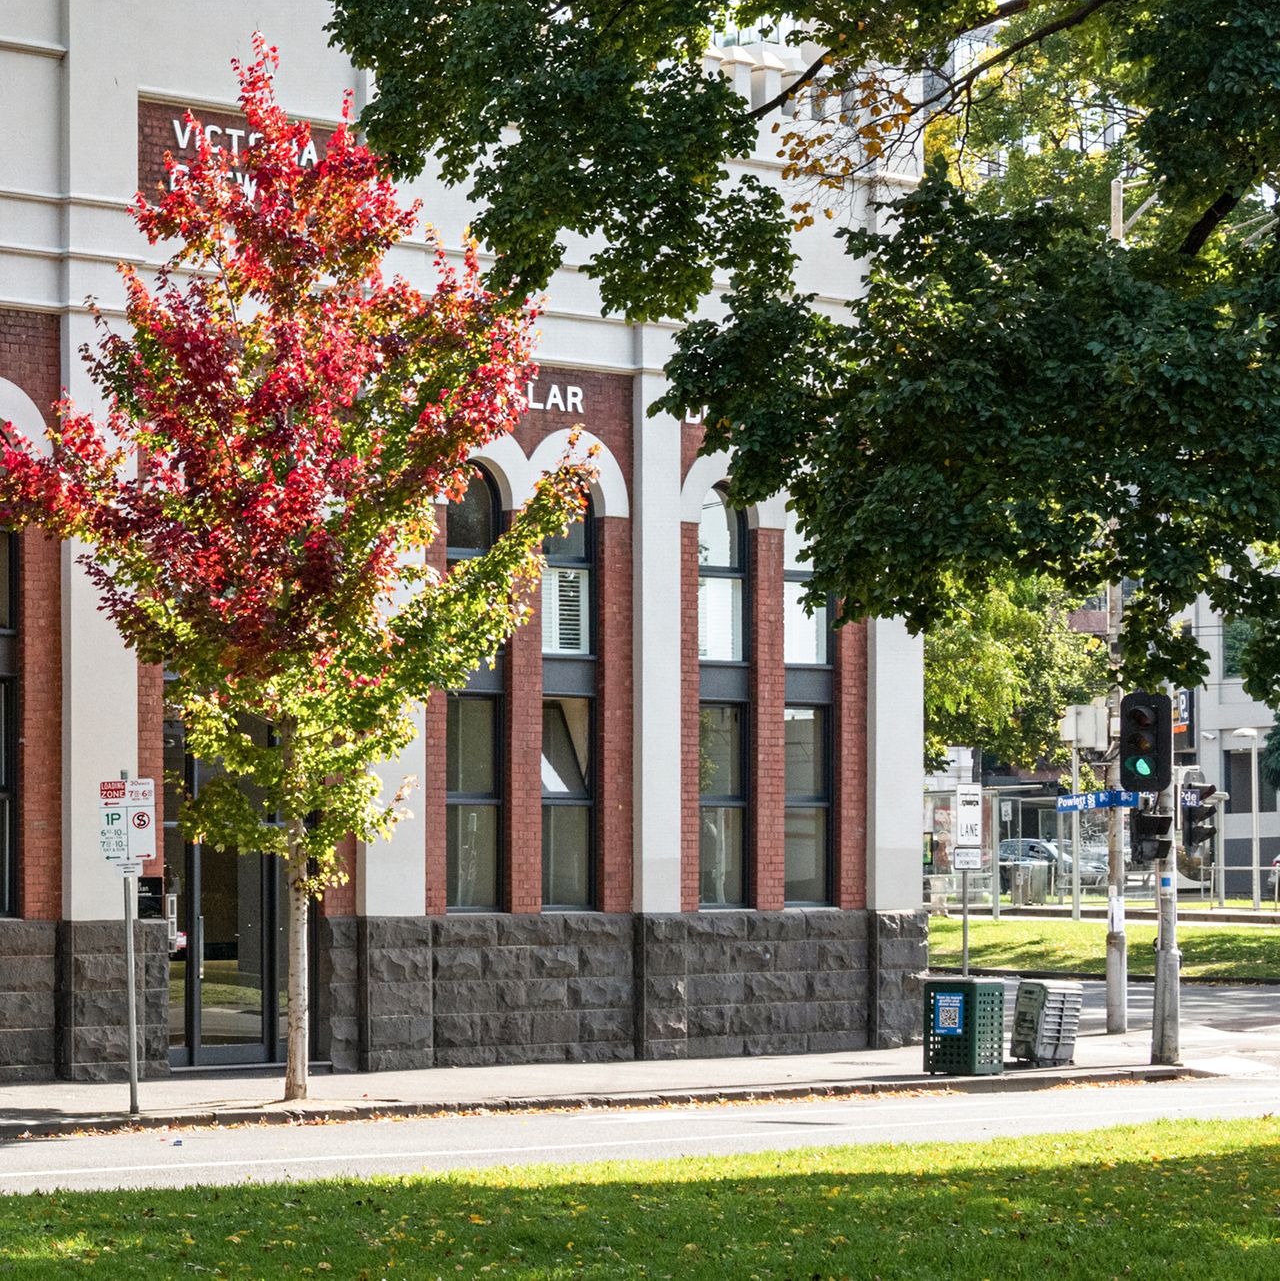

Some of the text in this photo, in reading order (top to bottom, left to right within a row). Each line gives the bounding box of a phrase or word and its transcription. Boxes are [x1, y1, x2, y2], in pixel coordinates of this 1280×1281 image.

[173, 120, 319, 167] VICTIA
[526, 382, 584, 413] LAR
[101, 790, 125, 798] ZONE
[1058, 796, 1086, 807] Powlett
[1087, 794, 1096, 804] St
[105, 813, 121, 825] 1P
[960, 823, 978, 837] LANE
